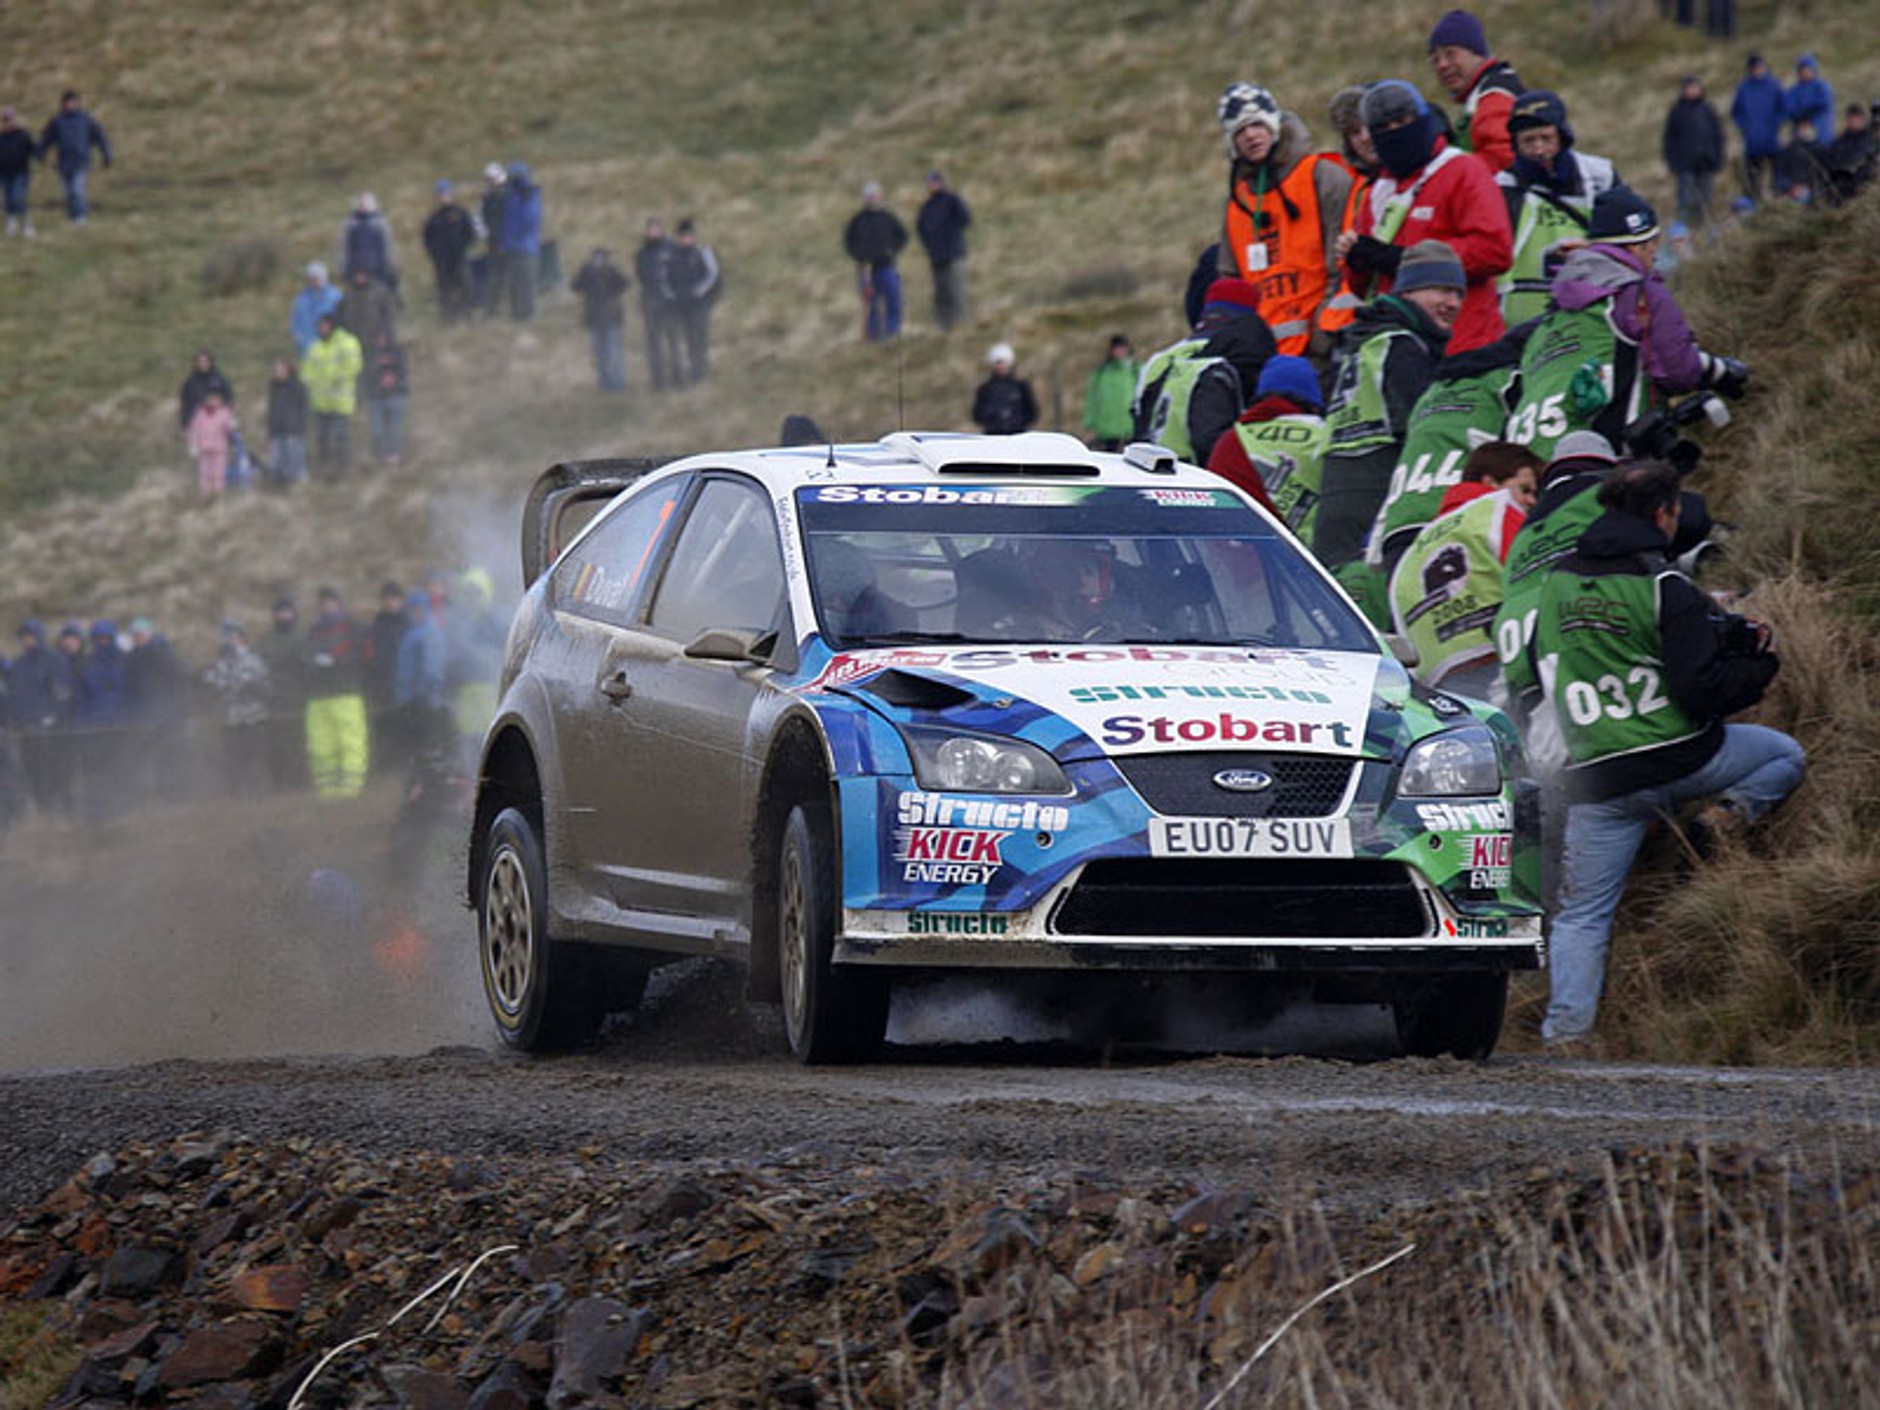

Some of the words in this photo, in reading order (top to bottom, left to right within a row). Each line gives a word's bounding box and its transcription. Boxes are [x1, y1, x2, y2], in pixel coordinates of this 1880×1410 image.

[1565, 666, 1669, 726] 032
[1103, 712, 1353, 749] Stobart
[907, 829, 1002, 862] KICK
[1164, 822, 1257, 852] EU07
[1269, 823, 1335, 852] SUV
[903, 863, 998, 884] ENERGY
